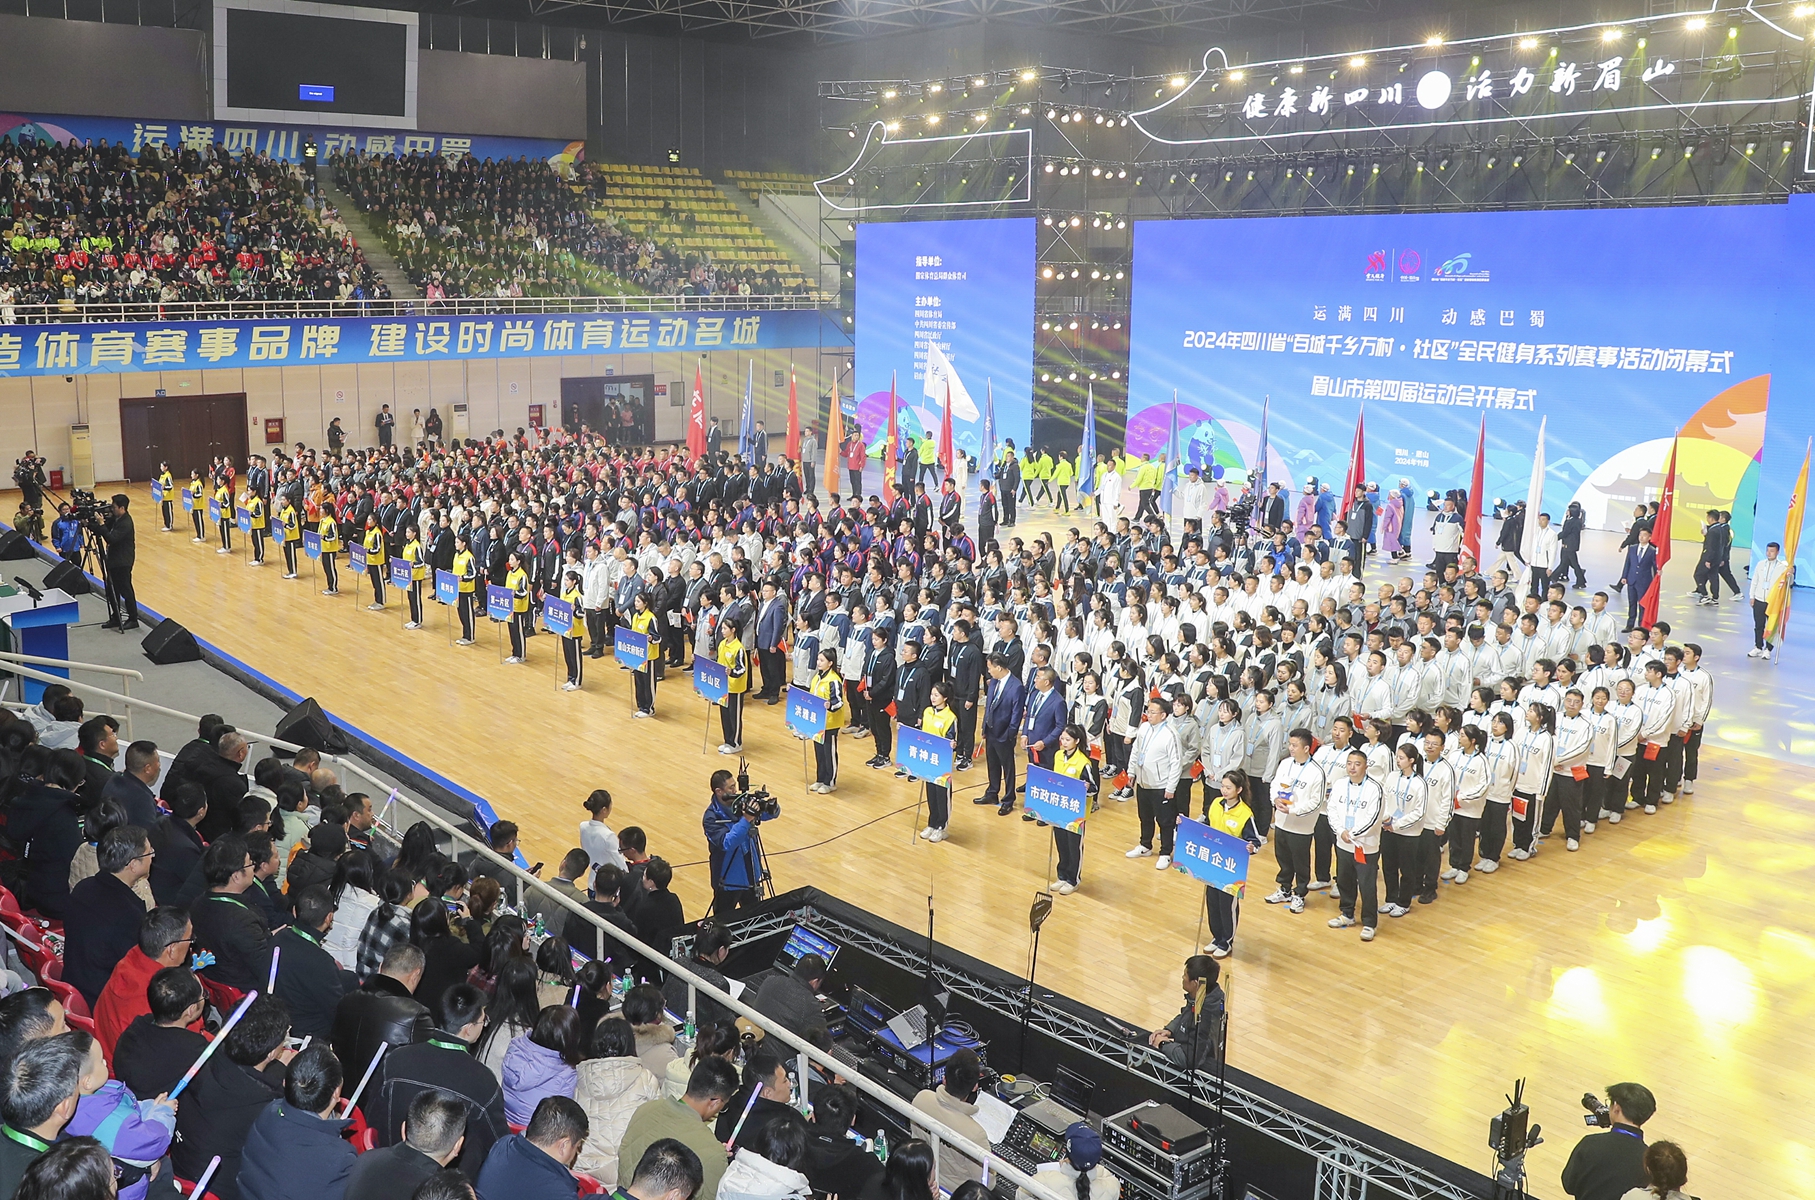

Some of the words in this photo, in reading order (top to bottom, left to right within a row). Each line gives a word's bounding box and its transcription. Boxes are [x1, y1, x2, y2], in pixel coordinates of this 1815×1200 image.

[1242, 82, 1402, 119] 健康新四川
[1467, 56, 1675, 101] 活力新眉山
[1313, 305, 1405, 323] 运满四川
[1441, 308, 1546, 328] 动感巴蜀
[368, 315, 762, 359] 建设时尚体育运动名城
[1310, 375, 1537, 411] 眉山市第四届运动会开幕式
[1394, 457, 1430, 468] 2024年11月
[393, 566, 409, 578] 第二片区
[490, 595, 510, 608] 第一片区
[548, 605, 570, 623] 第三片区
[617, 641, 645, 659] 眉山天府新区
[700, 671, 721, 690] 彭山区
[794, 703, 818, 725] 洪雅县
[908, 744, 940, 767] 青神县
[1029, 785, 1080, 814] 市政府系统
[1185, 840, 1237, 874] 在眉企业
